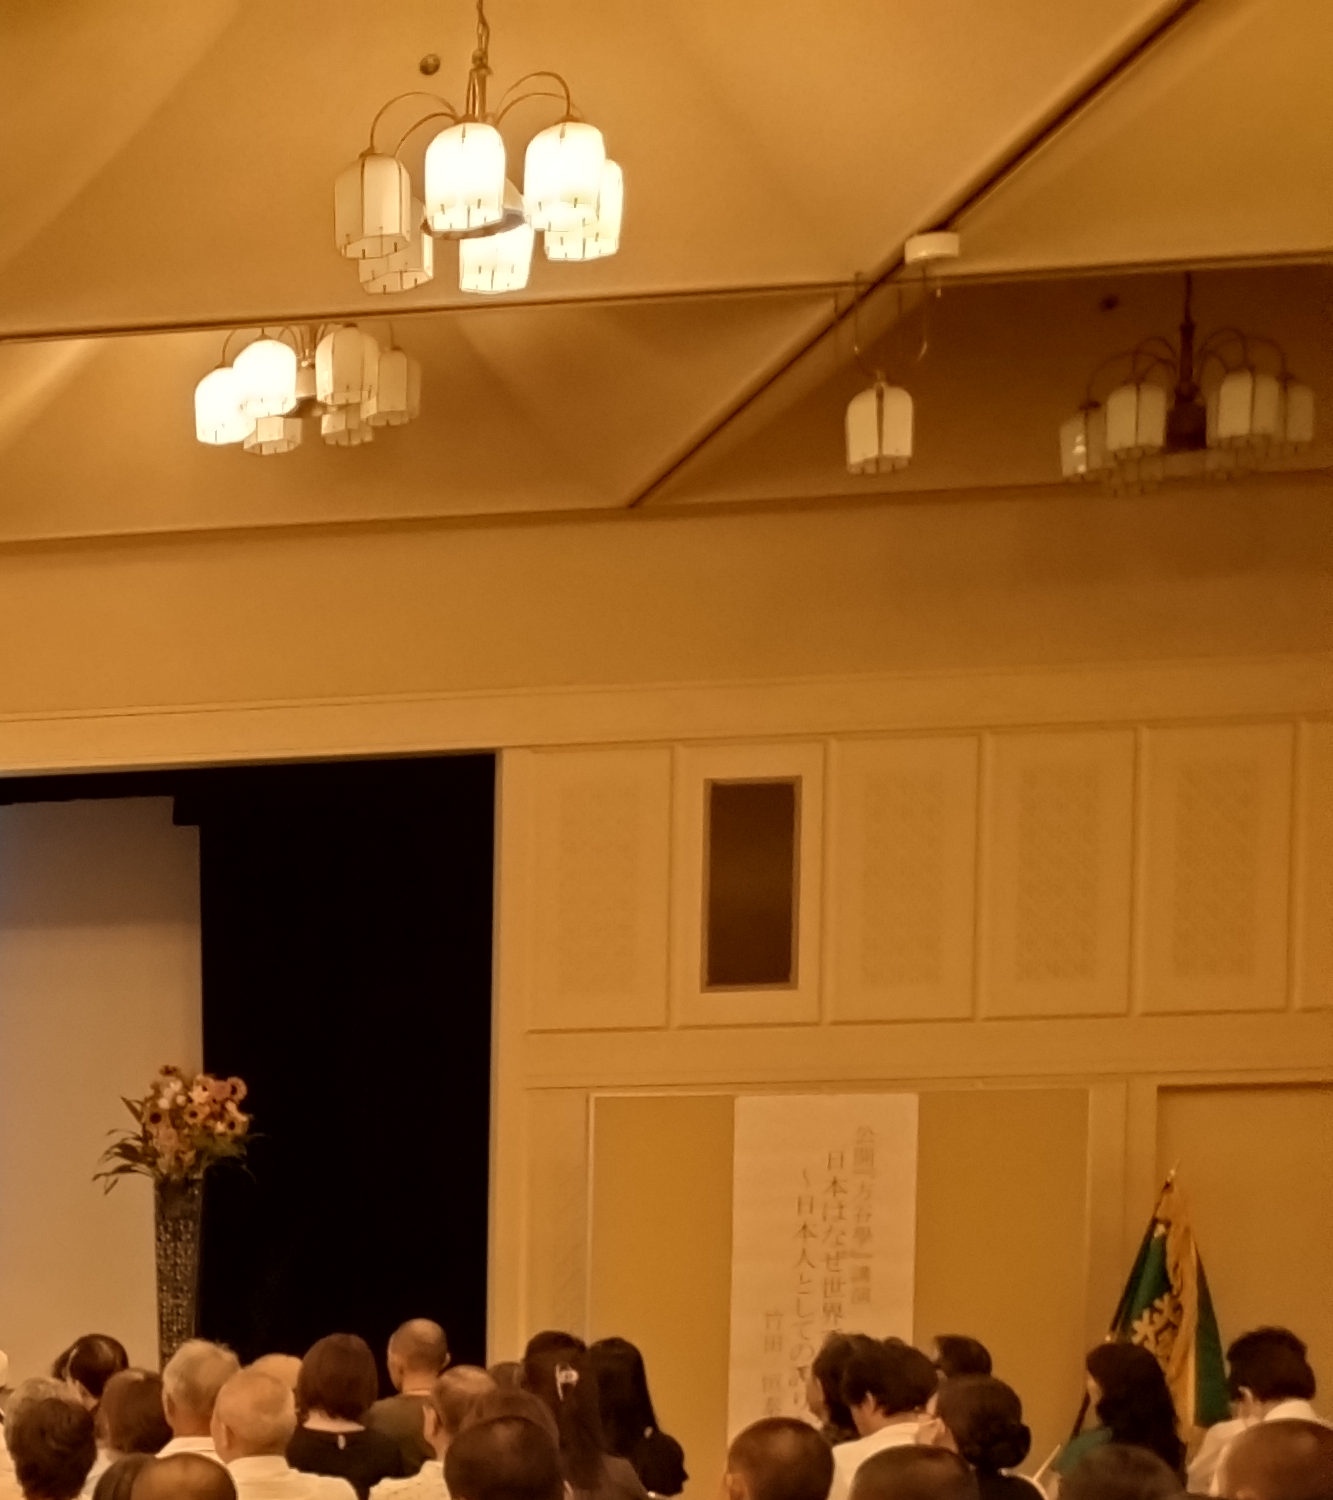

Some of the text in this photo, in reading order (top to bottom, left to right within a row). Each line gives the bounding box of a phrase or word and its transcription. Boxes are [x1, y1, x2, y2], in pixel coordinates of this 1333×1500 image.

[822, 1152, 848, 1333] 日本はなぜ世界
